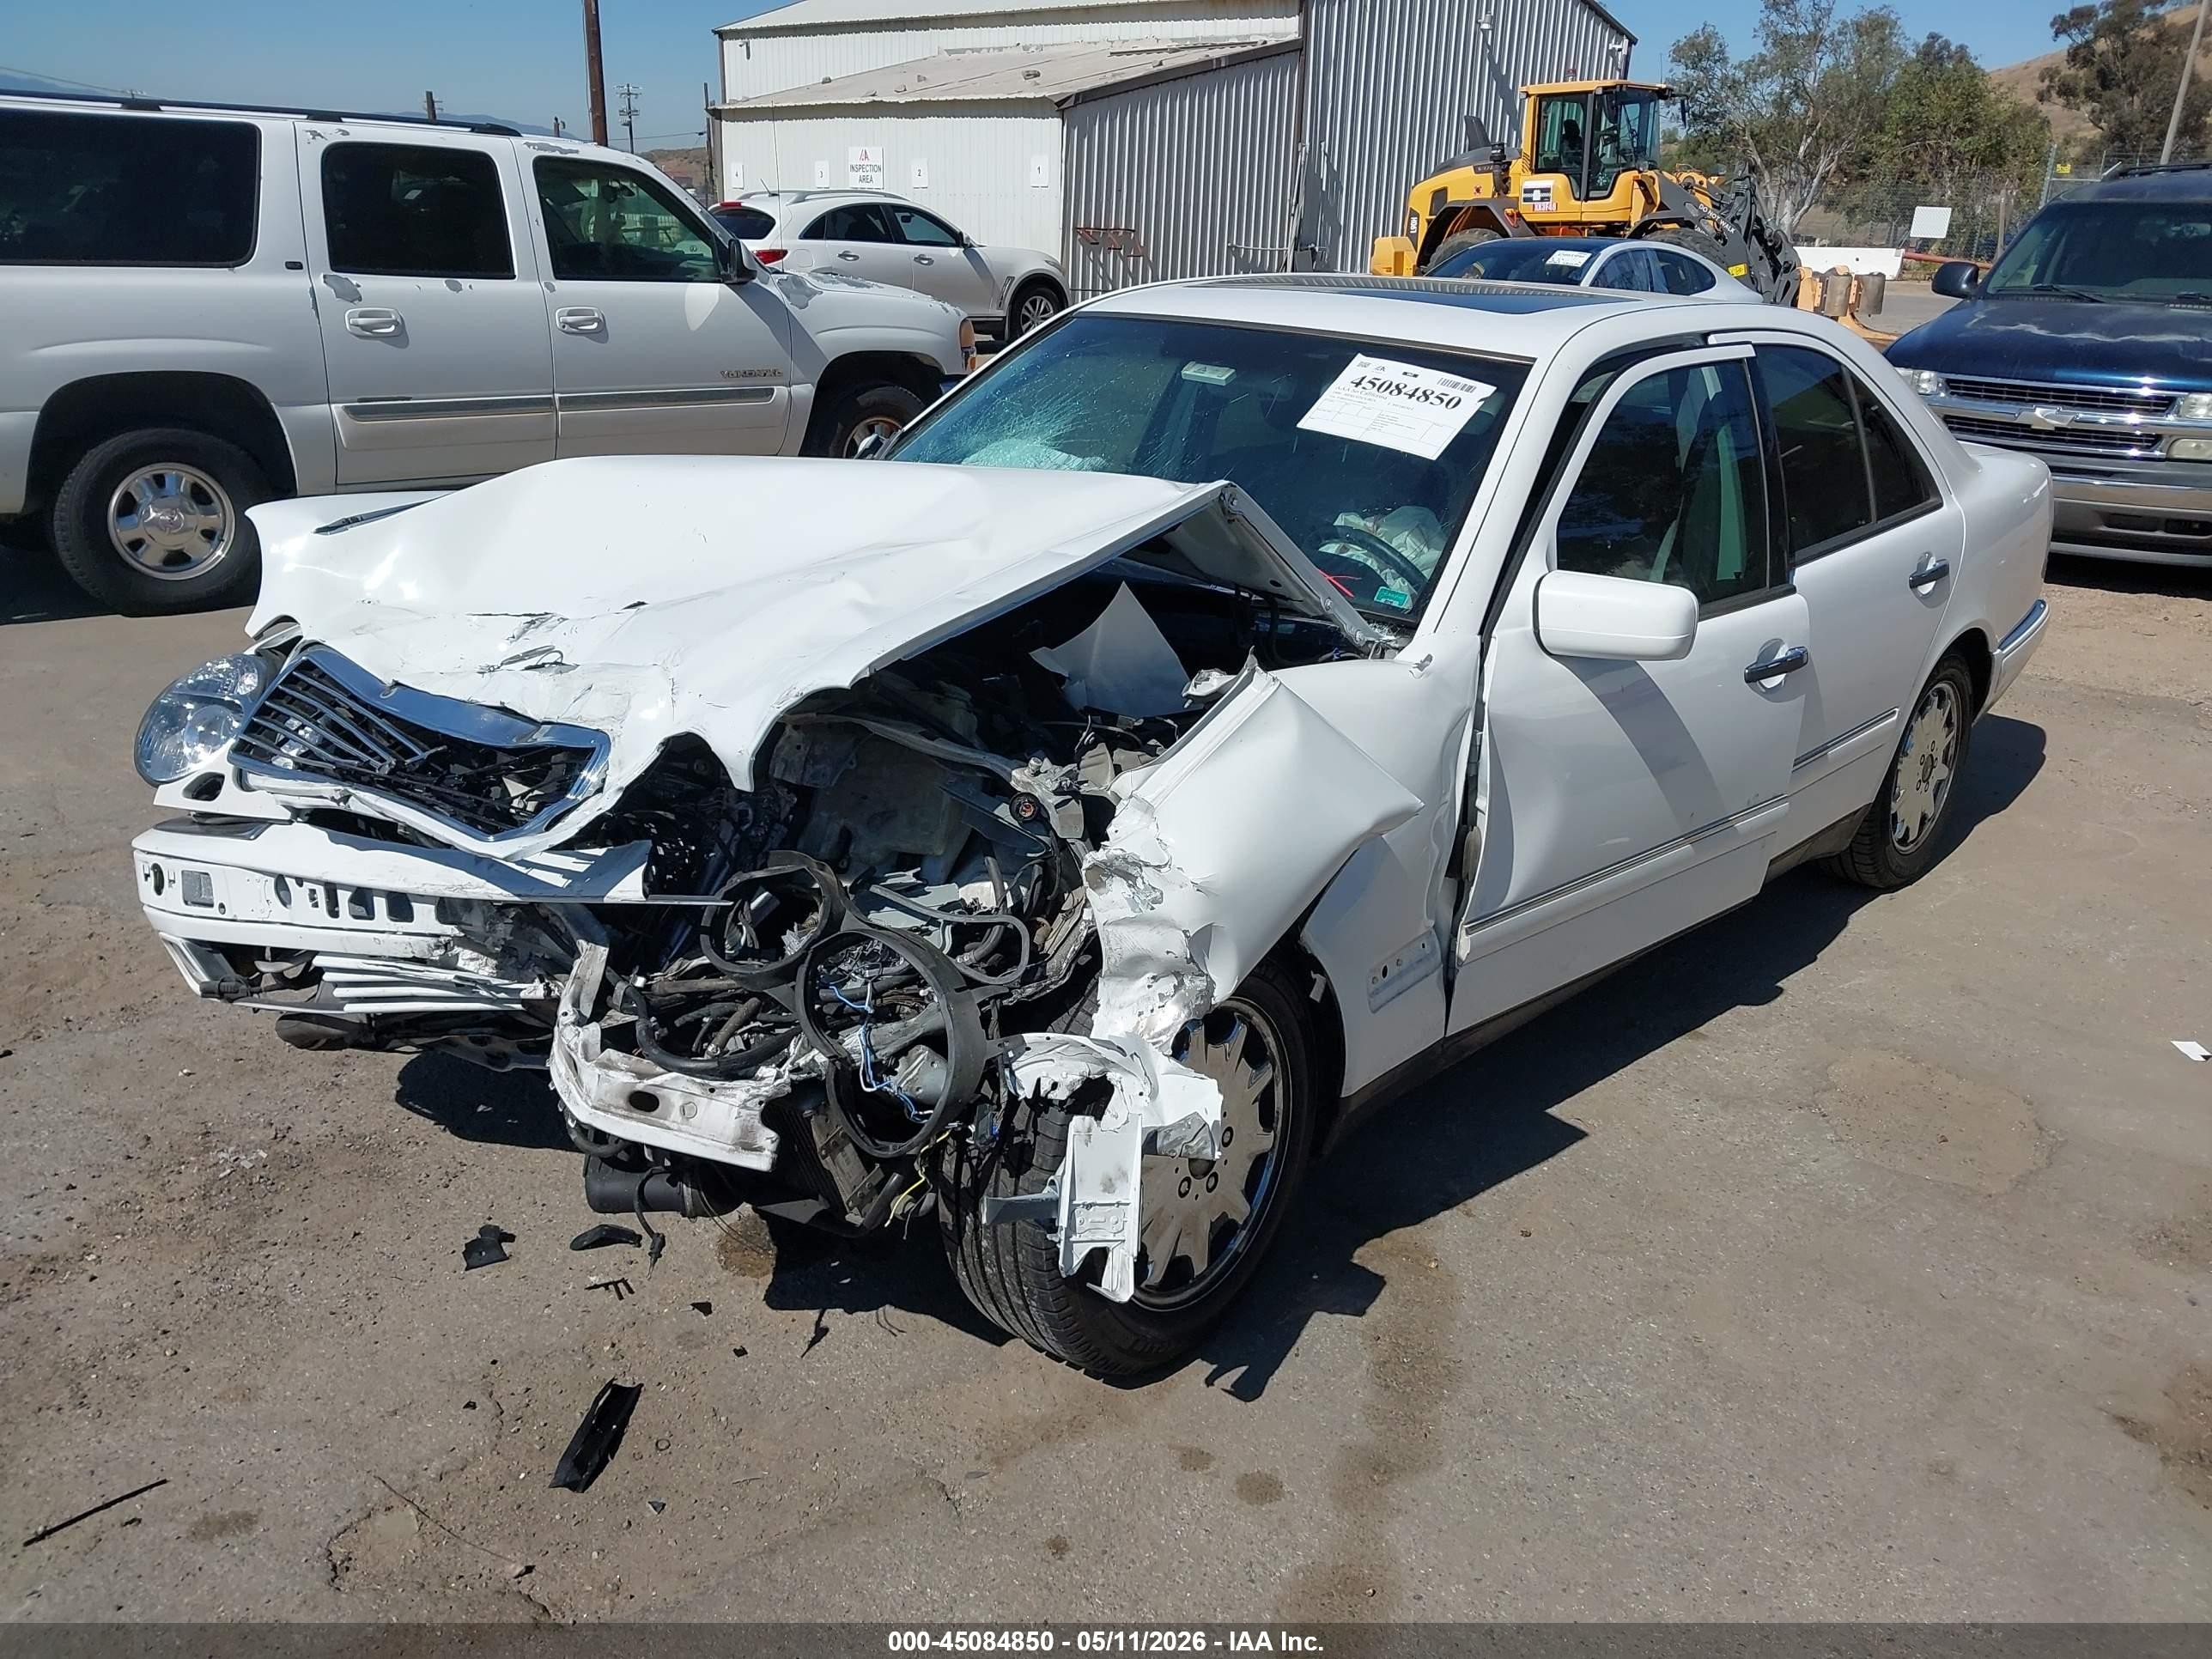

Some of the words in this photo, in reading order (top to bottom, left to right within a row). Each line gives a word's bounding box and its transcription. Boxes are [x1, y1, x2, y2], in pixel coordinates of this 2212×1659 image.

[849, 164, 882, 173] INSPECTION
[859, 174, 874, 184] AREA
[1698, 204, 1708, 212] DO
[1707, 210, 1720, 222] NOT
[1719, 220, 1735, 234] WALK
[1350, 375, 1462, 410] 45084850
